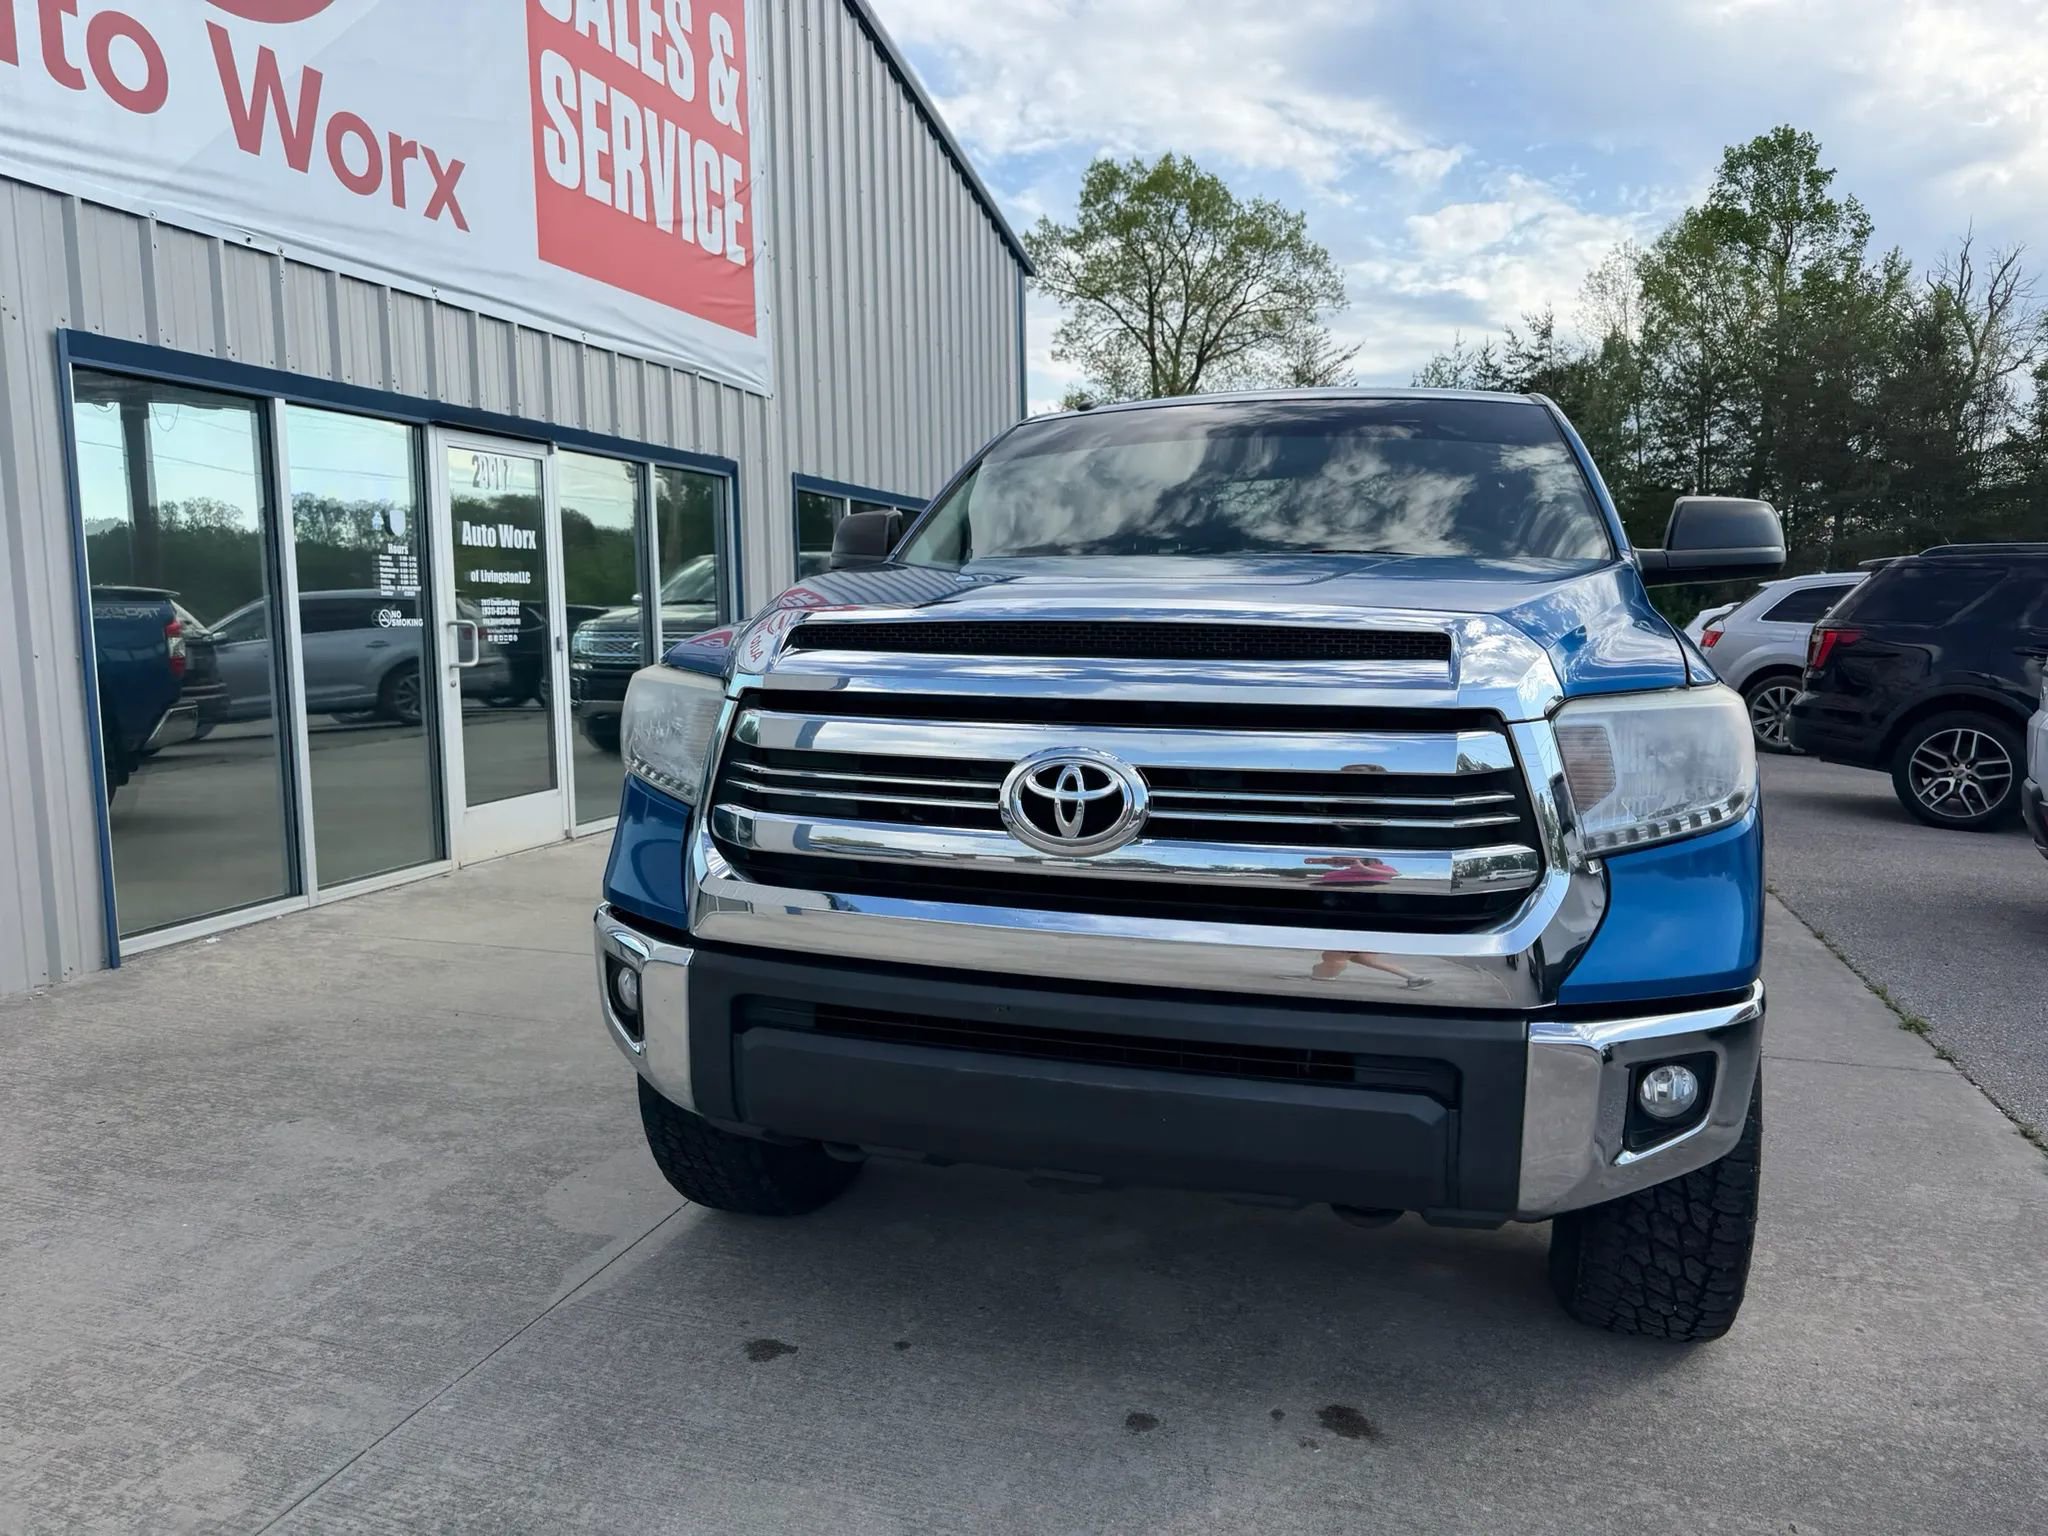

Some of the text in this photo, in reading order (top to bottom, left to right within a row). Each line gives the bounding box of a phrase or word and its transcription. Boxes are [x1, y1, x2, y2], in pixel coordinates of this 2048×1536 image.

[540, 0, 744, 135] LES &
[205, 19, 470, 233] Worx
[540, 48, 748, 267] SERVICE
[461, 520, 537, 550] Auto Worx
[391, 610, 402, 619] NO
[391, 617, 424, 628] SMOKING
